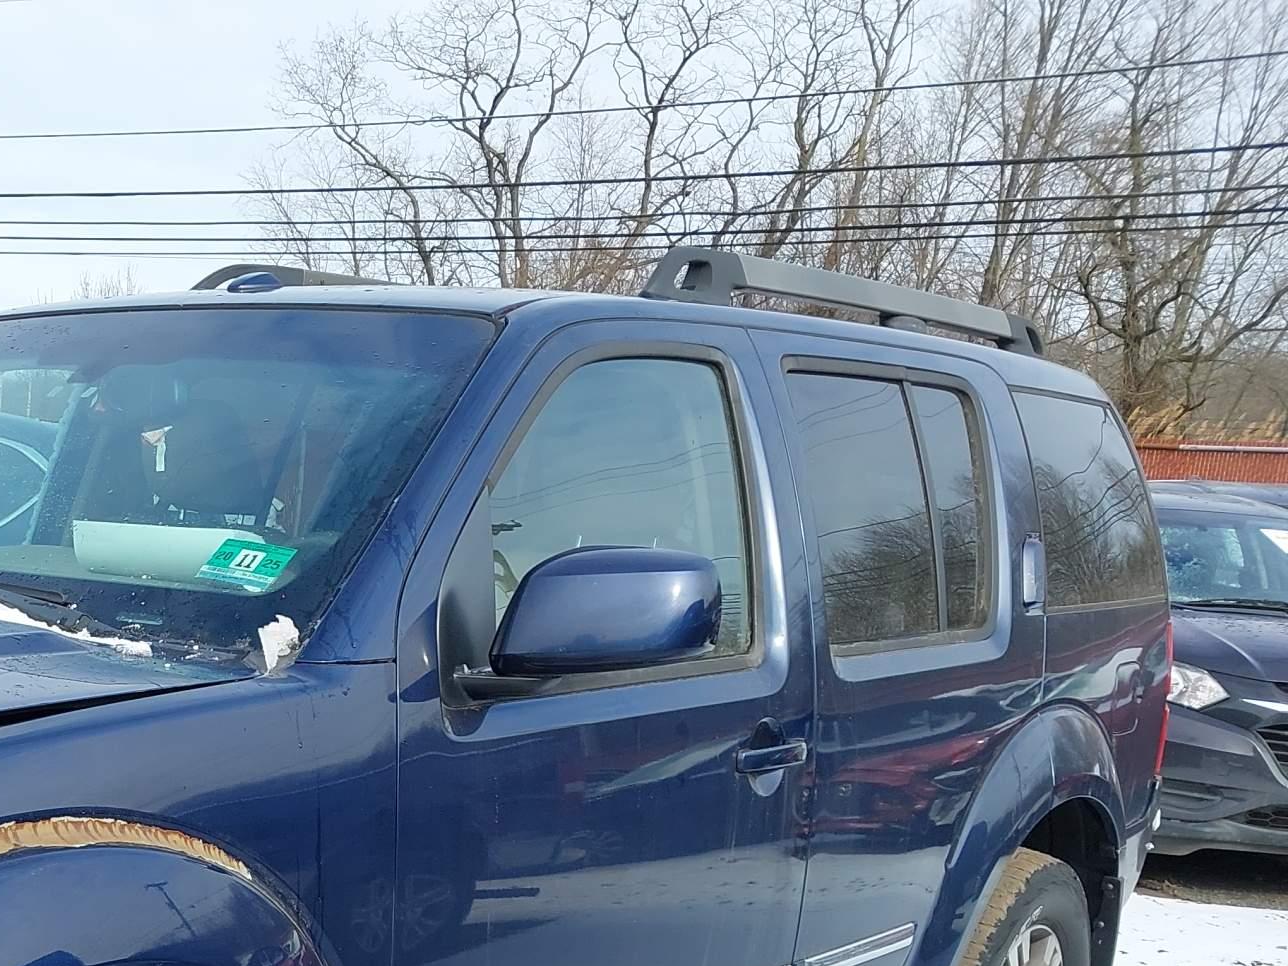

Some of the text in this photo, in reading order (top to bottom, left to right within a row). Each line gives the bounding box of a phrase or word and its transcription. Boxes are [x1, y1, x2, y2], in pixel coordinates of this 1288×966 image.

[215, 551, 282, 570] 20 11 25
